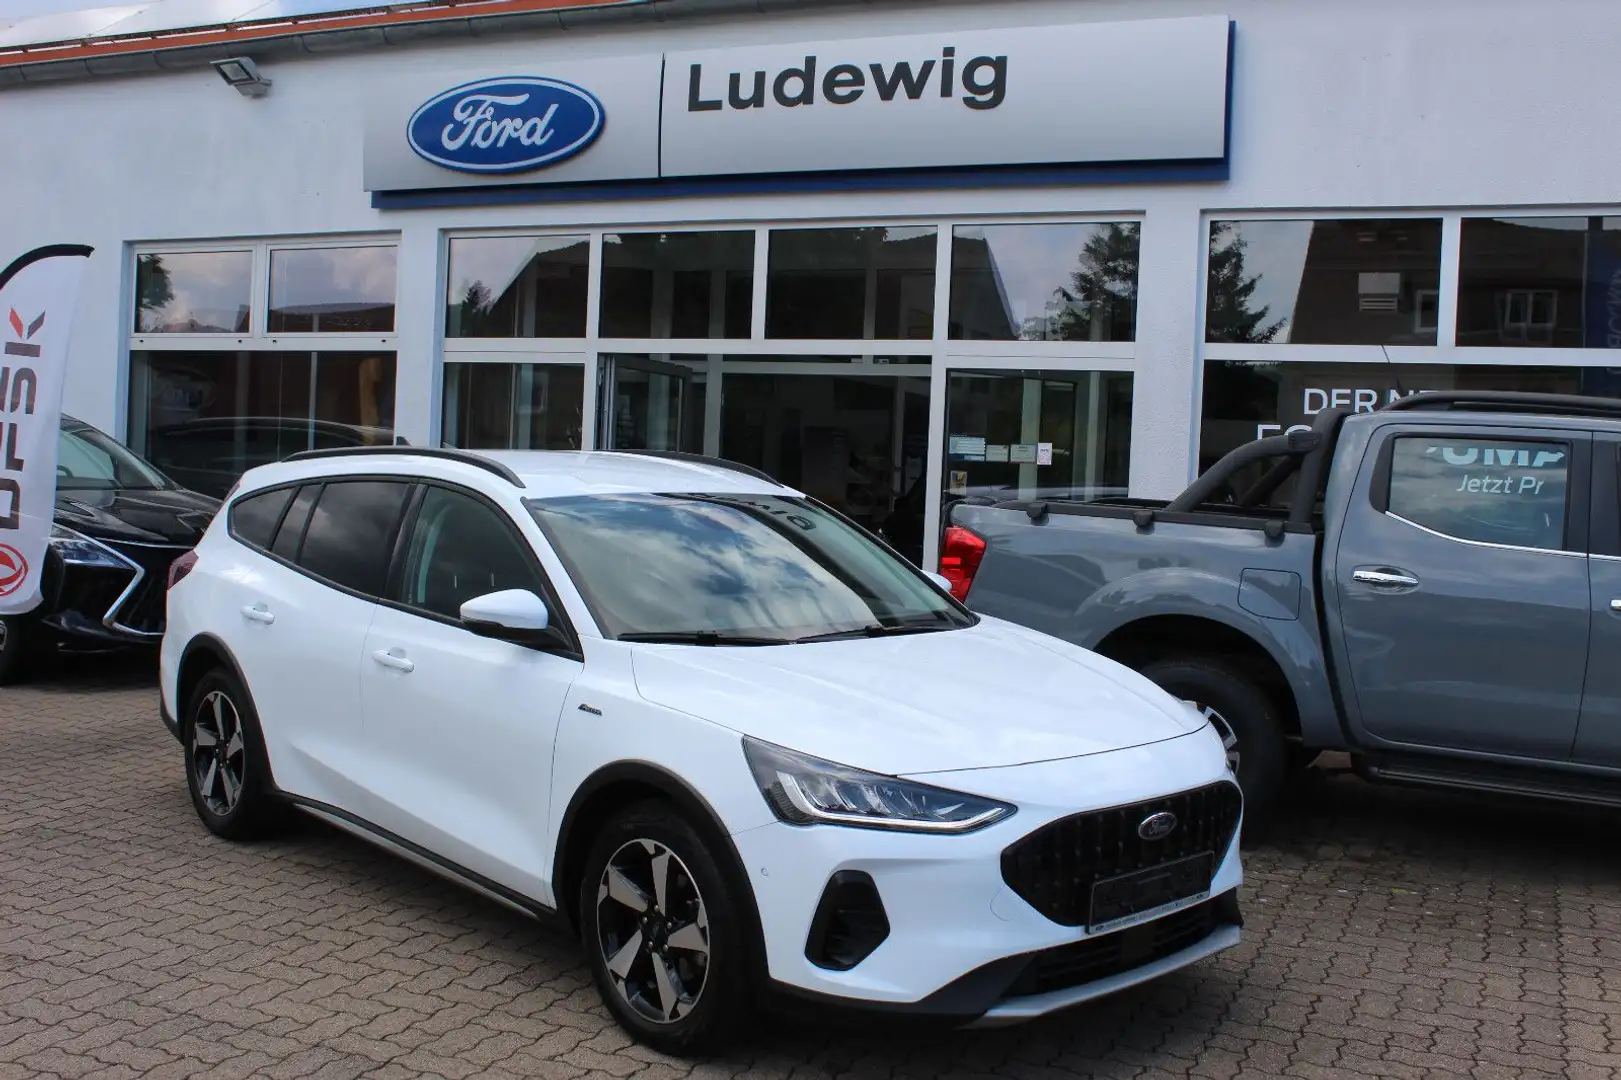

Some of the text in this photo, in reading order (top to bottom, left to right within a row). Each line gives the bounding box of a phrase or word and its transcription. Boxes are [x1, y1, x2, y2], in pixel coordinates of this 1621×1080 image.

[688, 46, 1008, 112] Ludewig
[441, 93, 559, 151] Ford
[1457, 474, 1514, 494] Jetzt
